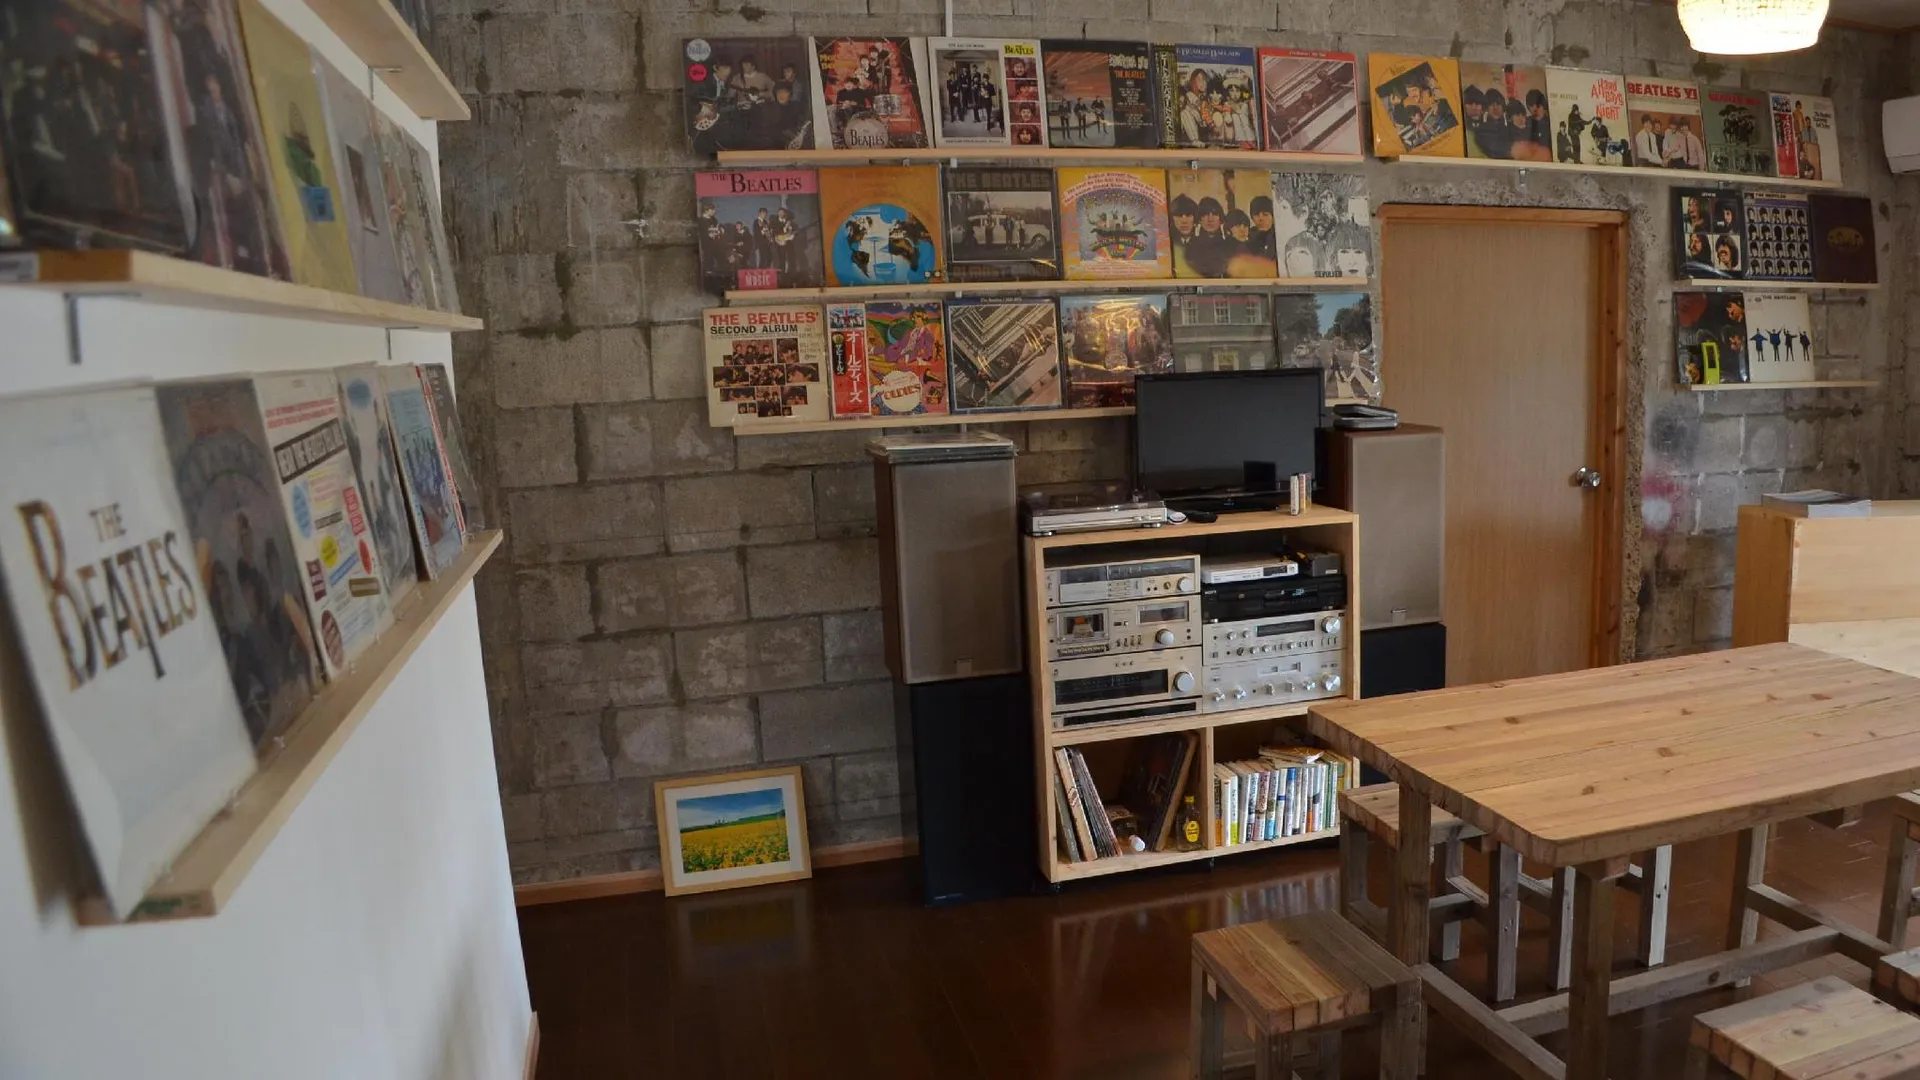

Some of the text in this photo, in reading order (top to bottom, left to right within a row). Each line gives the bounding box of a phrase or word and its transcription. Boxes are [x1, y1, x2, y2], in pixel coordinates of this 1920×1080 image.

[1627, 82, 1681, 98] BEATLES
[851, 128, 885, 148] BEATLES
[730, 173, 802, 193] BEATLES
[709, 311, 819, 325] THE BEATLES'
[710, 324, 798, 335] SECOND ALBUM
[847, 331, 863, 403] オールディーズ
[89, 502, 127, 542] THE
[15, 498, 198, 694] BEATLES
